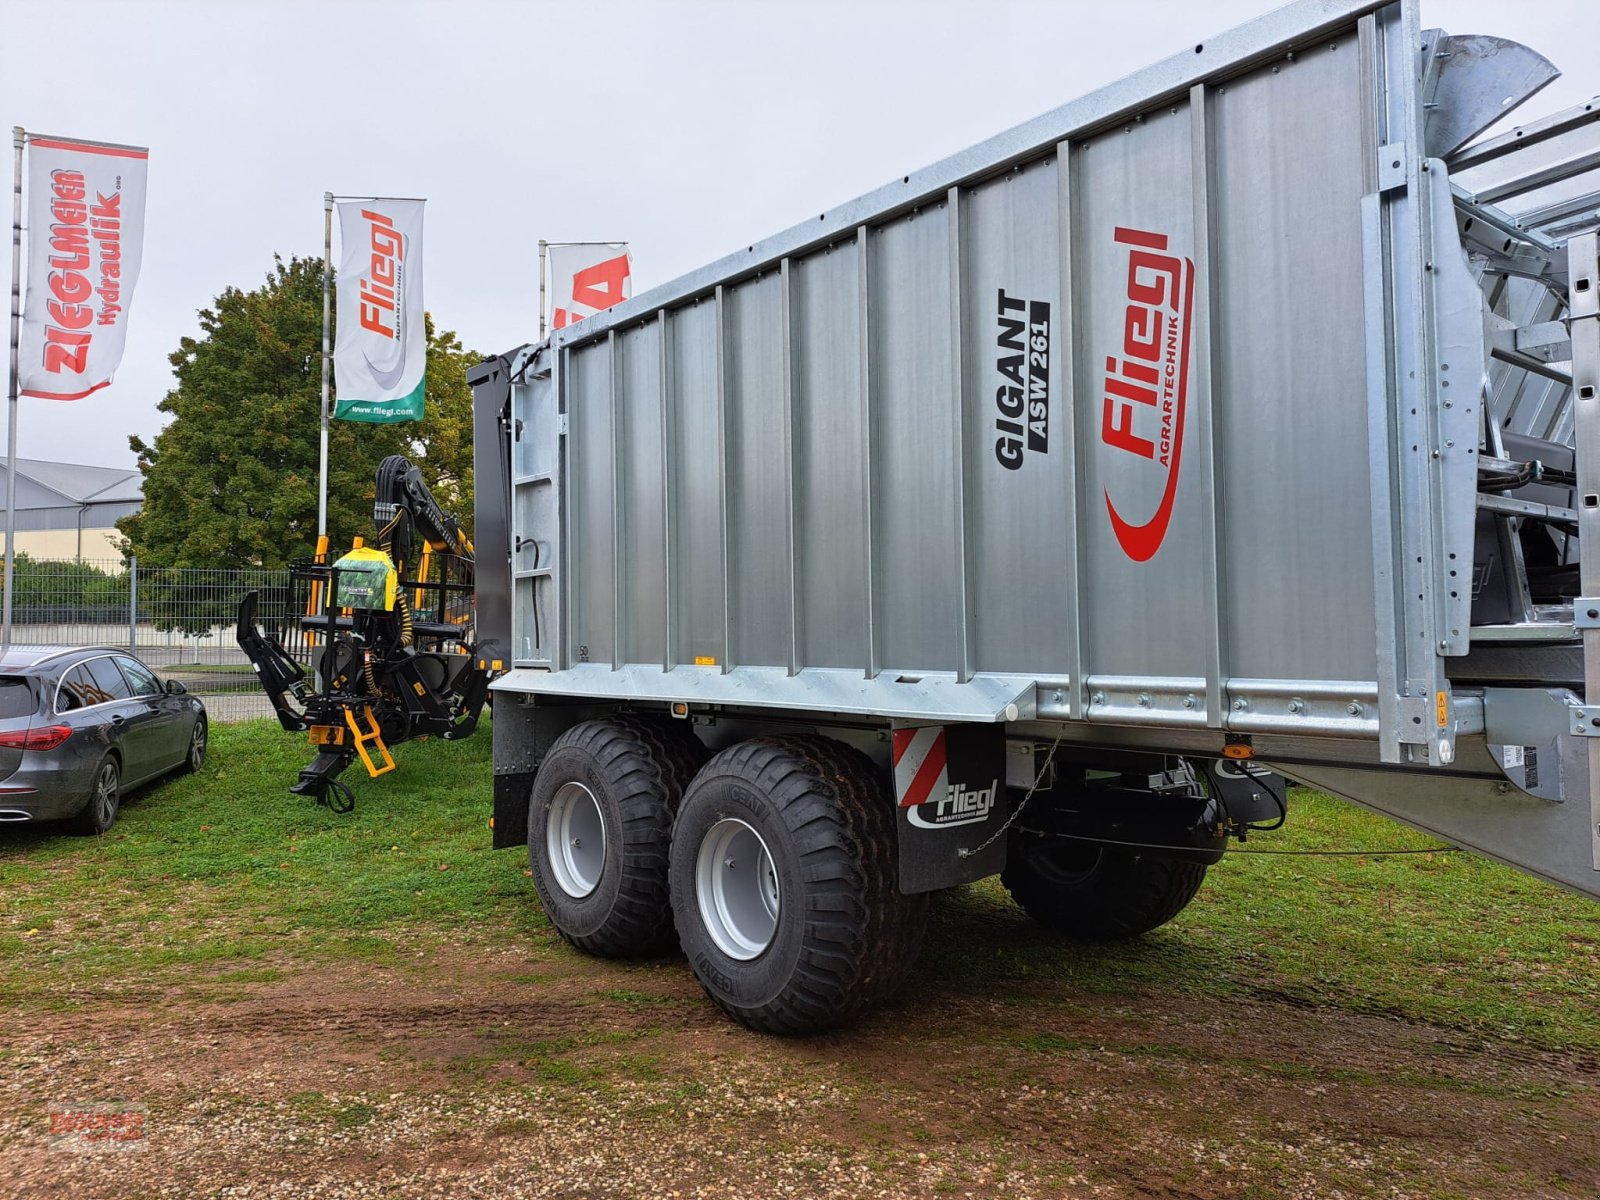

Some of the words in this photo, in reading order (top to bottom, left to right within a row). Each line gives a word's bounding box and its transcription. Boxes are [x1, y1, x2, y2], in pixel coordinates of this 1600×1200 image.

[43, 169, 93, 374] ZIEGLMEIER
[90, 191, 122, 326] Hydraulik
[360, 209, 404, 339] Fliegl
[995, 288, 1026, 471] GIGANT
[1029, 374, 1048, 438] ASW
[1030, 320, 1048, 369] 261
[1102, 226, 1182, 460] Fliegl
[1159, 315, 1179, 468] AGRARTECHNIK
[351, 406, 414, 417] www.fliegl.com
